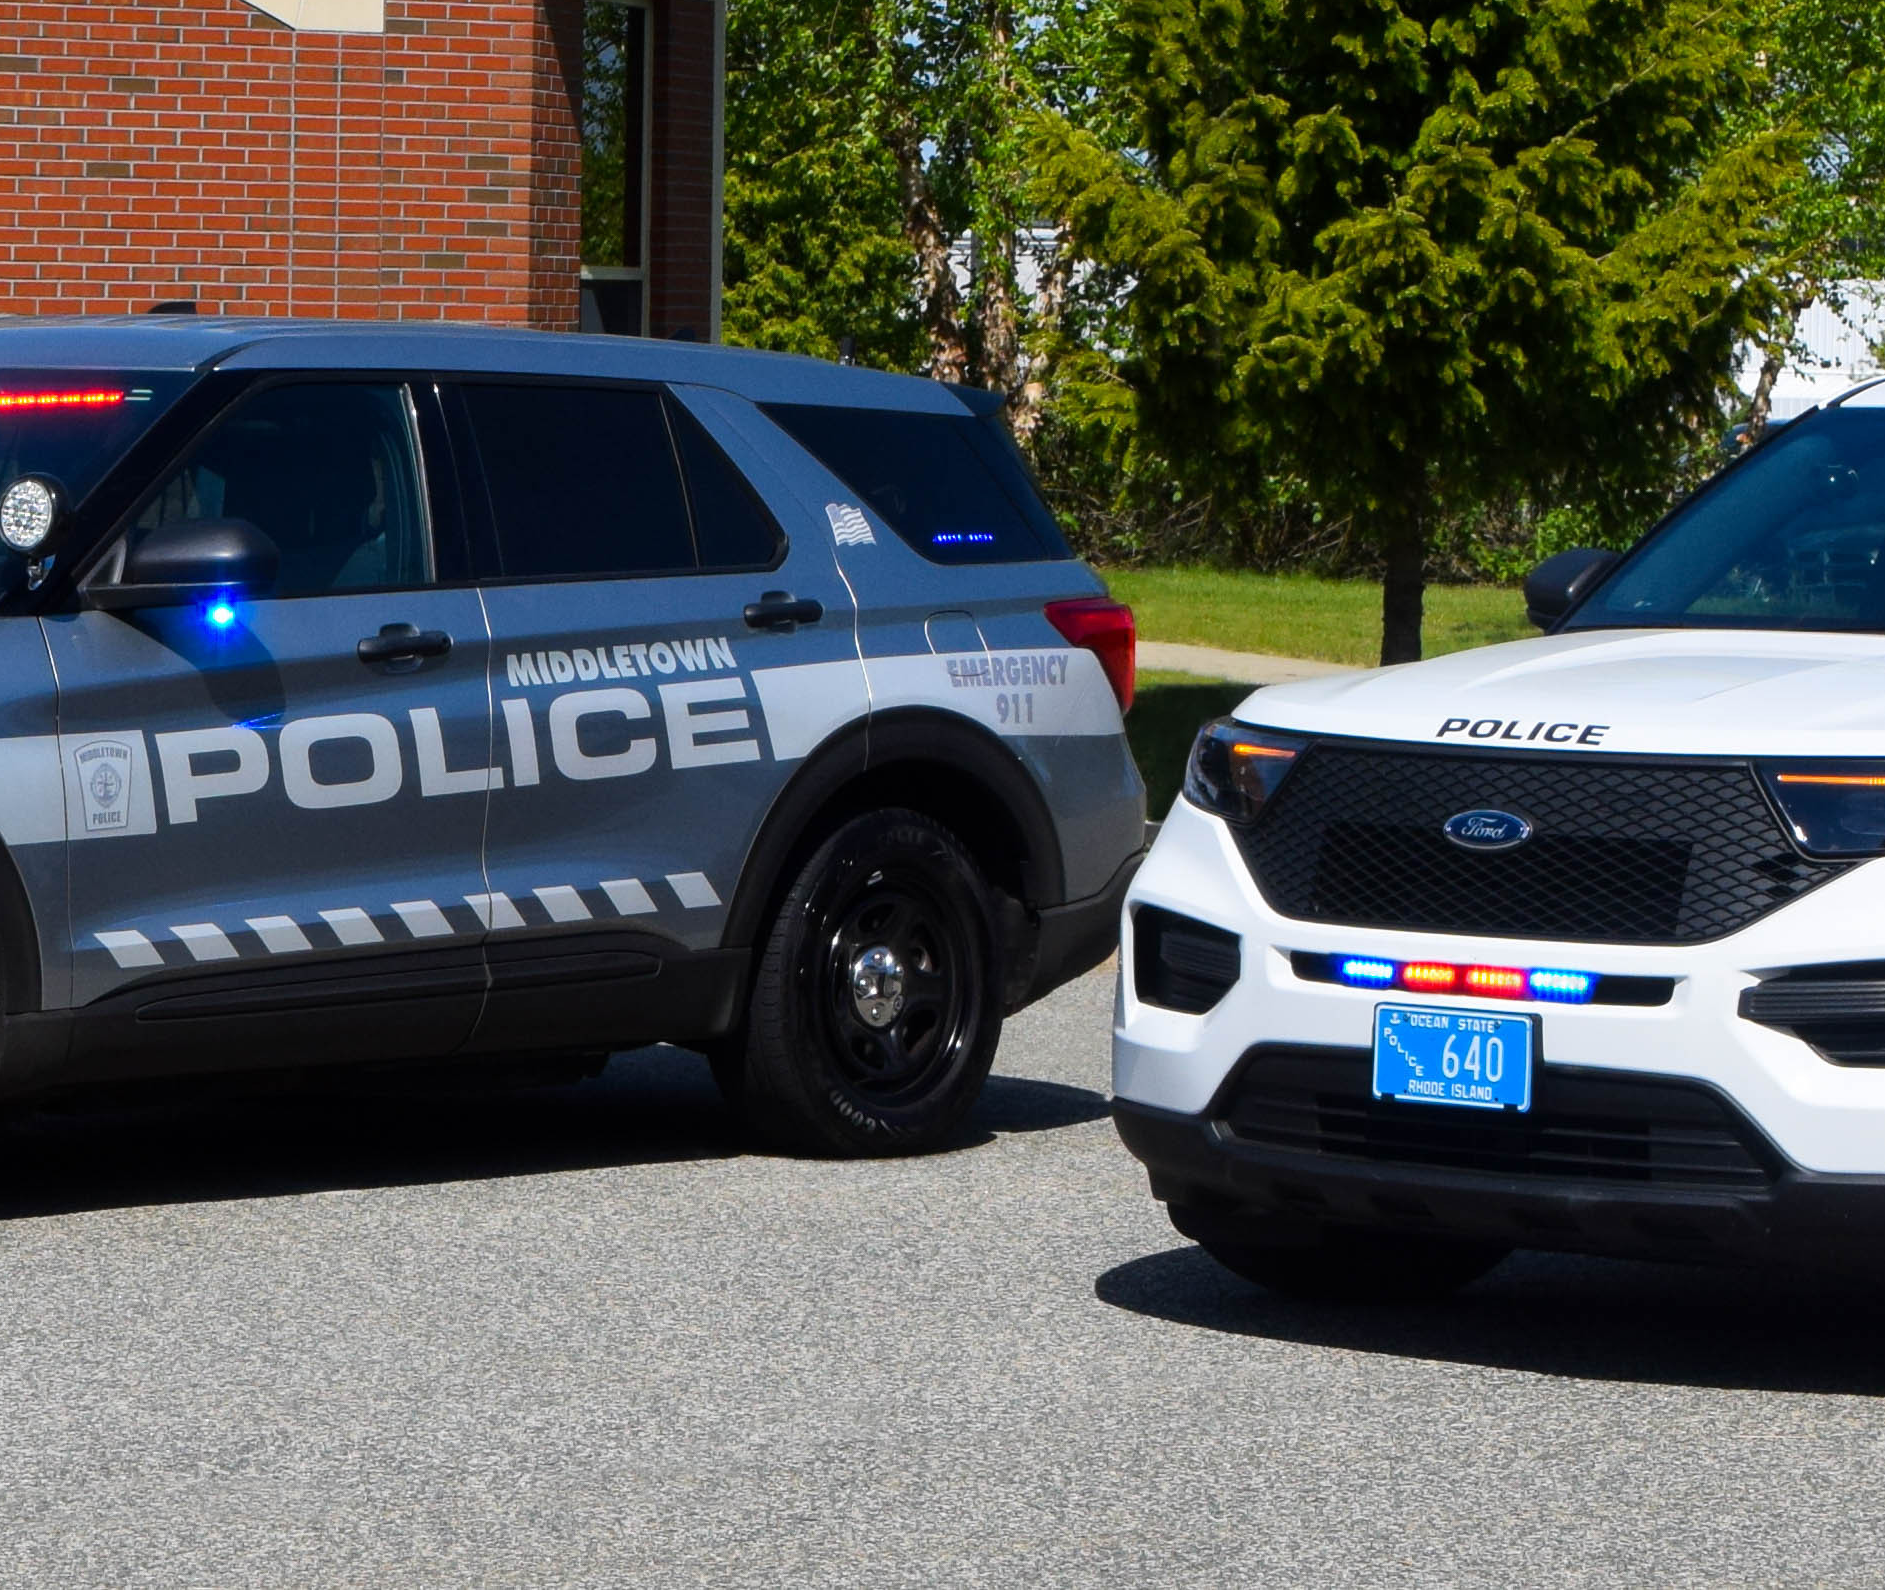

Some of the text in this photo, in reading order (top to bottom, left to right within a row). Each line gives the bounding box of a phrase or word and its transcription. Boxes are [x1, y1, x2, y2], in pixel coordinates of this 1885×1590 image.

[505, 636, 737, 688] MIDDLETOWN
[946, 654, 1068, 688] EMERGENCY
[996, 693, 1033, 724] 911
[1435, 718, 1612, 746] POLICE
[155, 676, 762, 825] POLICE
[92, 810, 122, 825] POLICE
[1461, 816, 1509, 840] Ford
[1384, 1027, 1424, 1077] POLICE
[1442, 1034, 1504, 1083] 640
[1408, 1079, 1493, 1101] RHODE ISLAND
